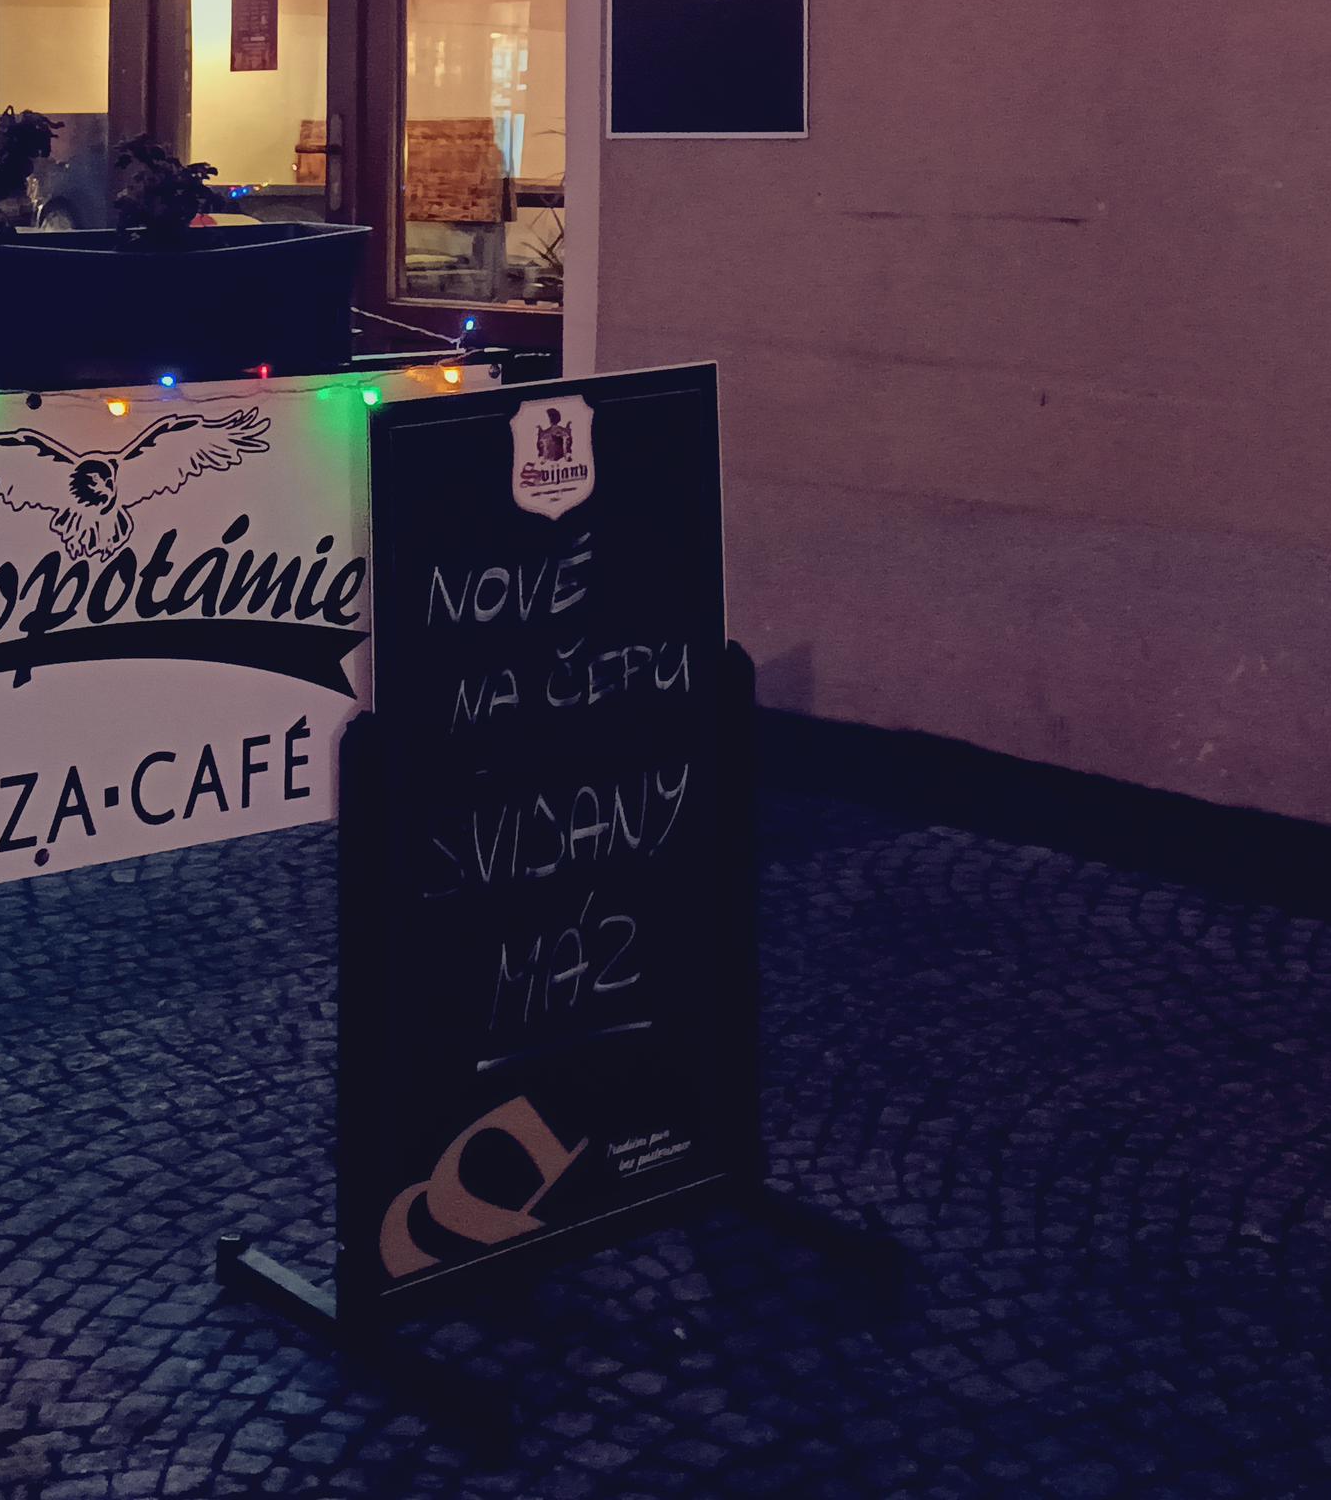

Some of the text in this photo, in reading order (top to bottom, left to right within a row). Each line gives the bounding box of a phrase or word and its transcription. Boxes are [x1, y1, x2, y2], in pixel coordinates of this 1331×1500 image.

[426, 531, 593, 627] NOVÉ
[449, 668, 520, 735] NA
[130, 714, 313, 827] CAFÉ
